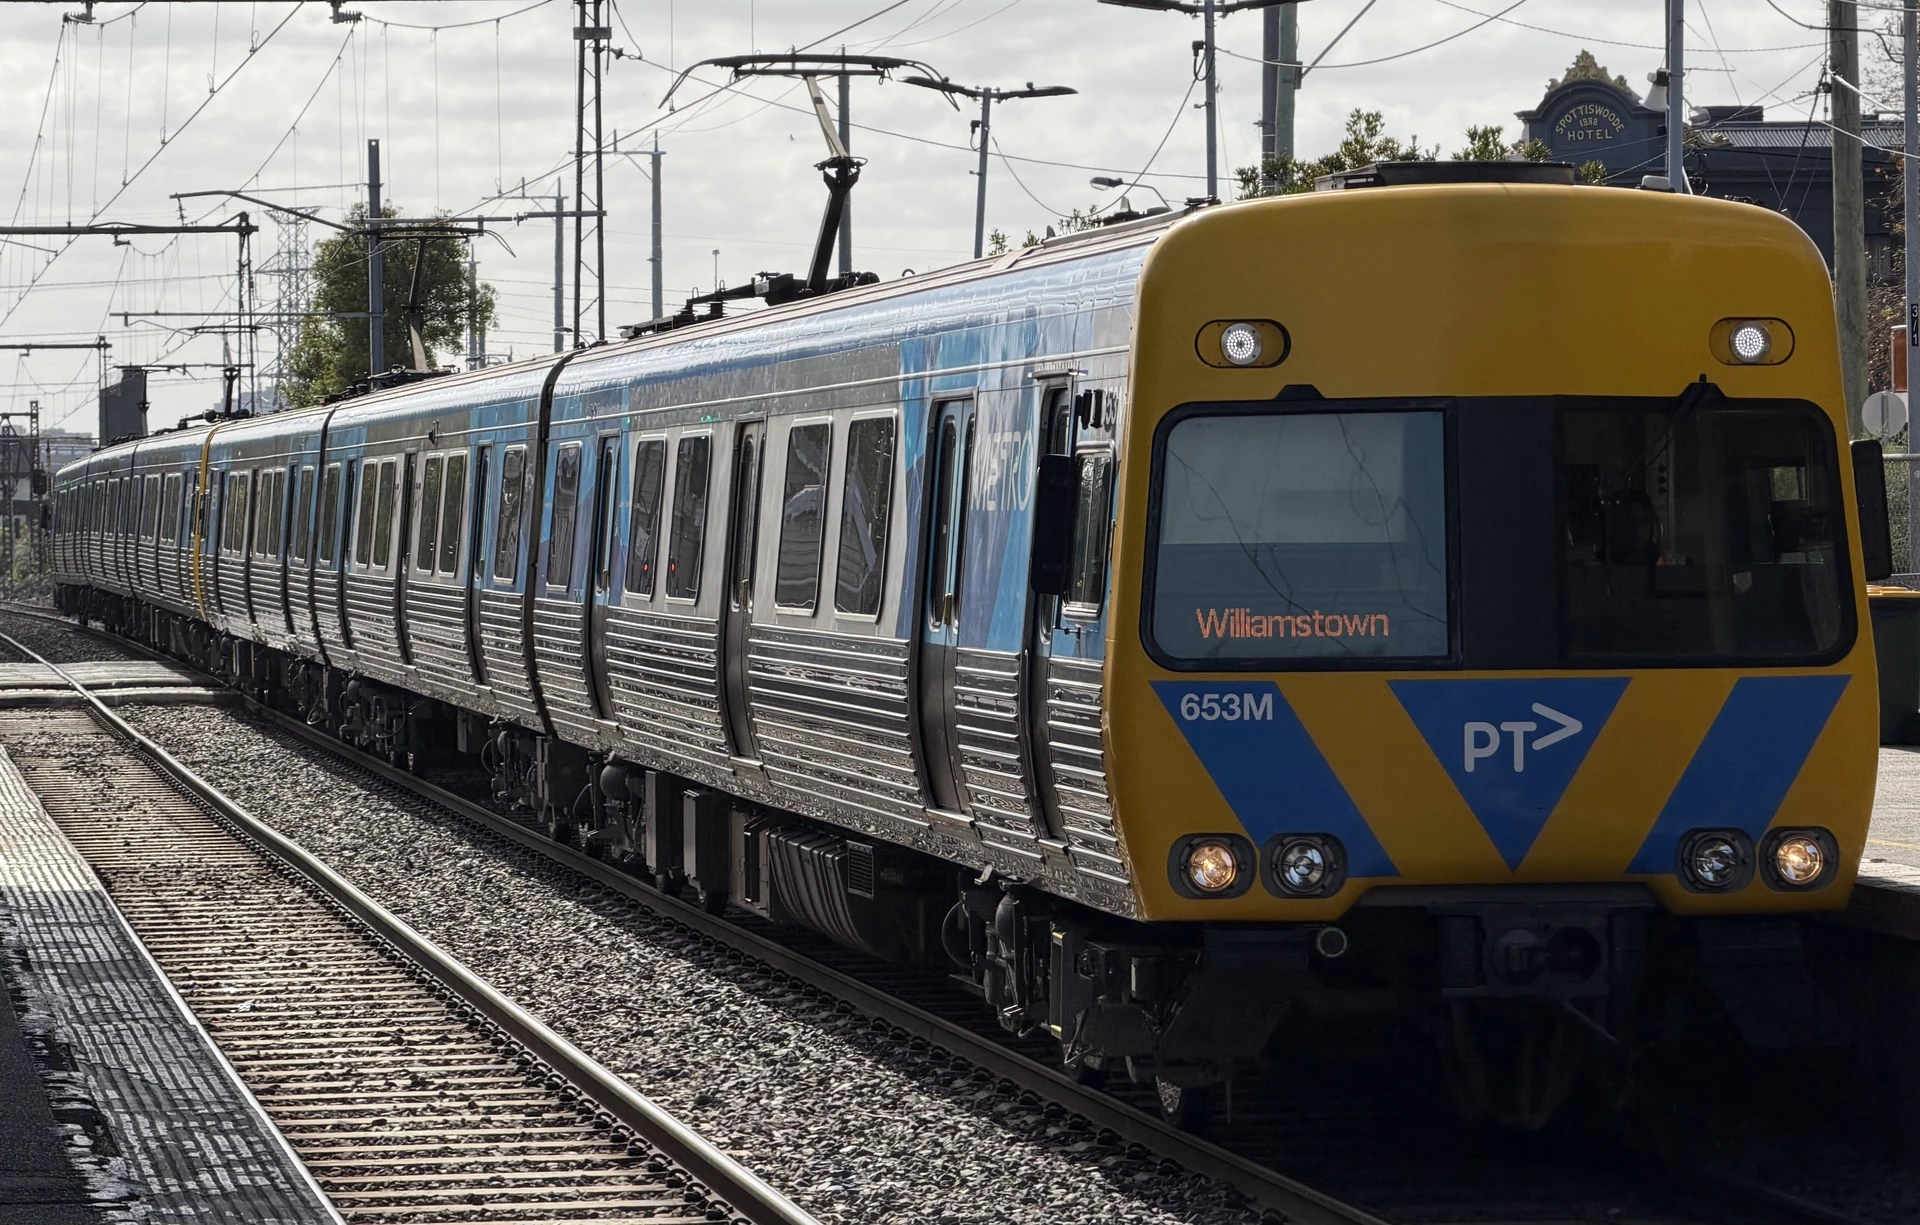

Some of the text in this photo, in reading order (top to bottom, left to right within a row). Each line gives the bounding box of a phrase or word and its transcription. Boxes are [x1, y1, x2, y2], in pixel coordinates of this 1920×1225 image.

[1555, 104, 1625, 134] SPOTTISWOODE
[1567, 129, 1612, 140] HOTEL
[970, 430, 1034, 512] METRO
[1195, 608, 1390, 639] Williamstown
[1180, 693, 1274, 721] 653M
